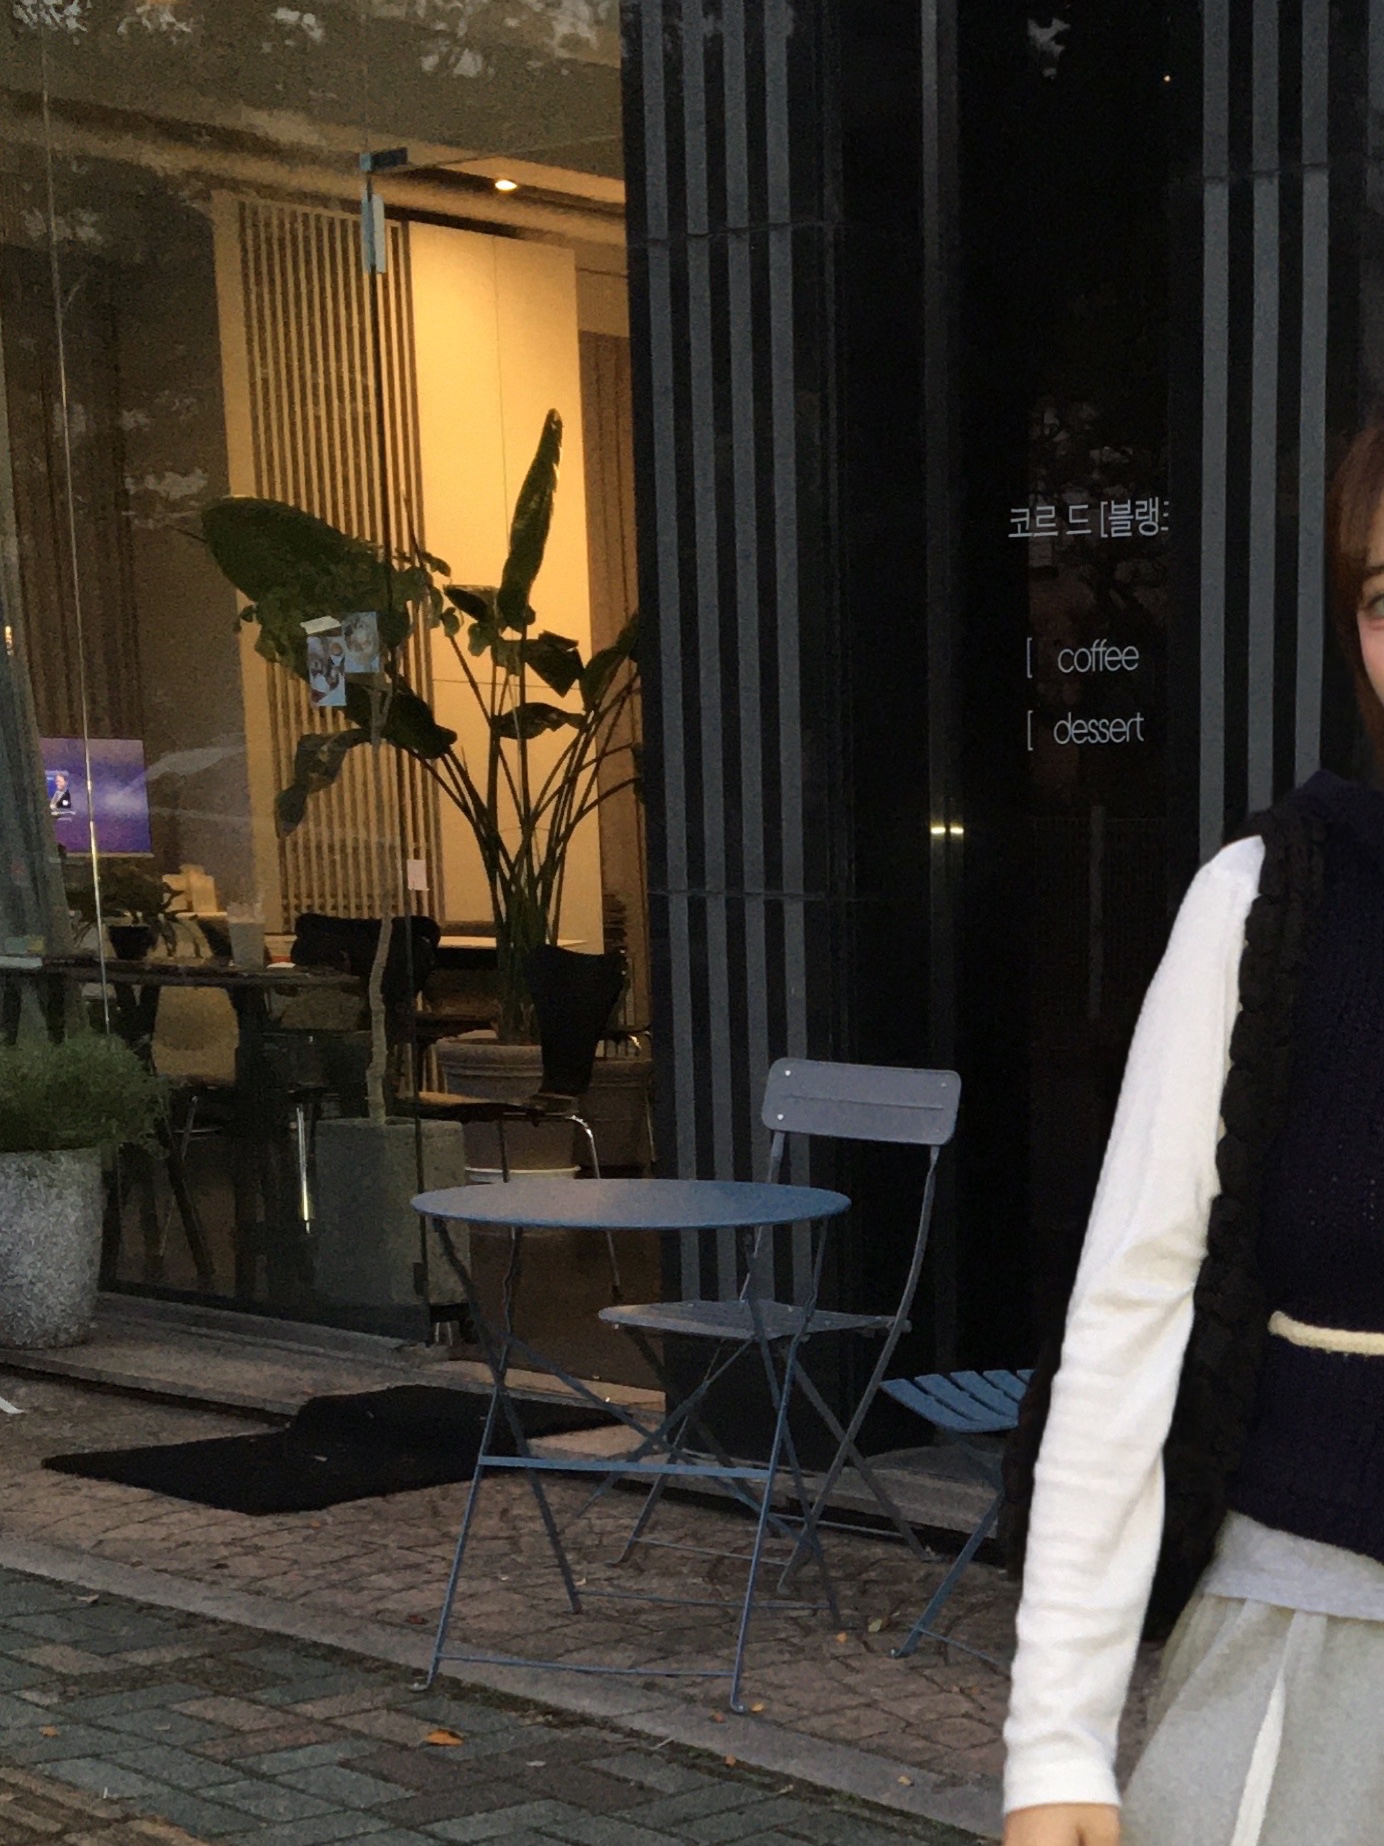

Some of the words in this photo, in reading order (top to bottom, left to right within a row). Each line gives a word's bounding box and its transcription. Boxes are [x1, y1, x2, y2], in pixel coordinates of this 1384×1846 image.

[1008, 506, 1058, 537] 코르
[1066, 505, 1092, 535] 드
[1057, 639, 1139, 673] coffee
[1054, 712, 1144, 744] dessert
